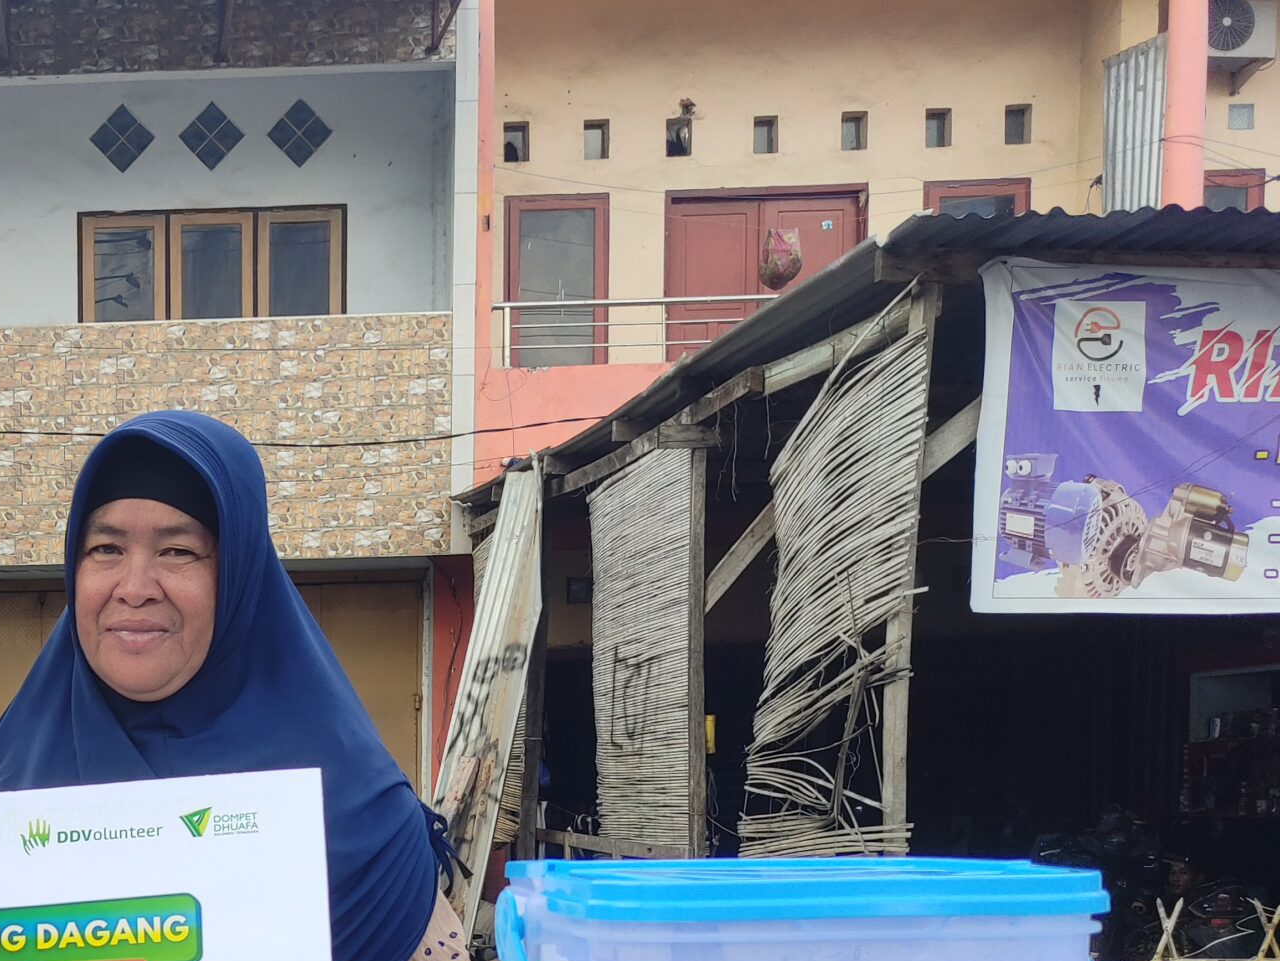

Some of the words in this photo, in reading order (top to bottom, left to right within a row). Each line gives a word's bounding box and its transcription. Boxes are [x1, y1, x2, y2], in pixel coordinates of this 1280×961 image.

[1056, 361, 1083, 372] RIAN
[1086, 362, 1141, 372] ELECTRIC
[1186, 325, 1280, 403] RI
[1064, 374, 1097, 383] service
[213, 811, 258, 824] DOMPET
[213, 821, 259, 833] DHUAFA
[57, 825, 164, 844] DDVolunteer
[36, 914, 191, 951] DAGANG
